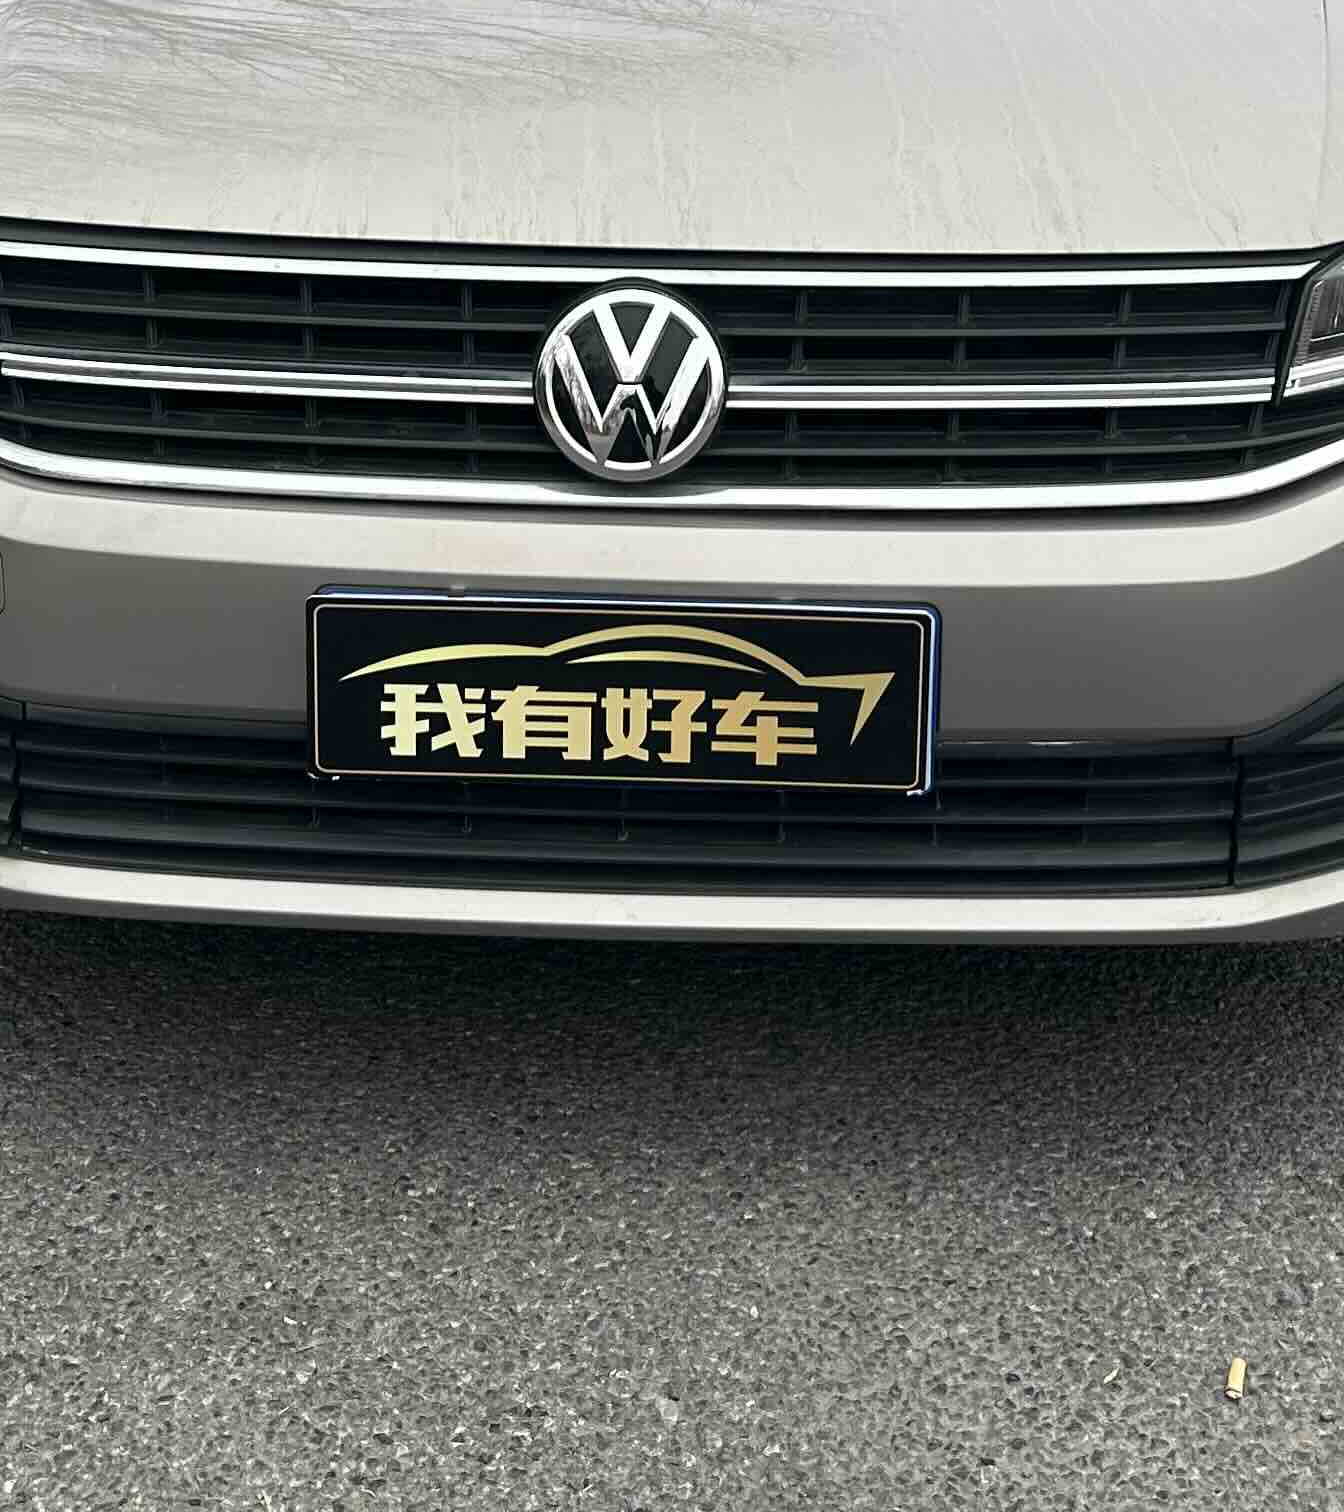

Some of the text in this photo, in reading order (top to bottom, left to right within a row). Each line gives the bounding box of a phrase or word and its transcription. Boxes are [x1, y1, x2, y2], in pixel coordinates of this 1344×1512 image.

[540, 291, 721, 476] VW
[379, 682, 819, 767] 我有好车
